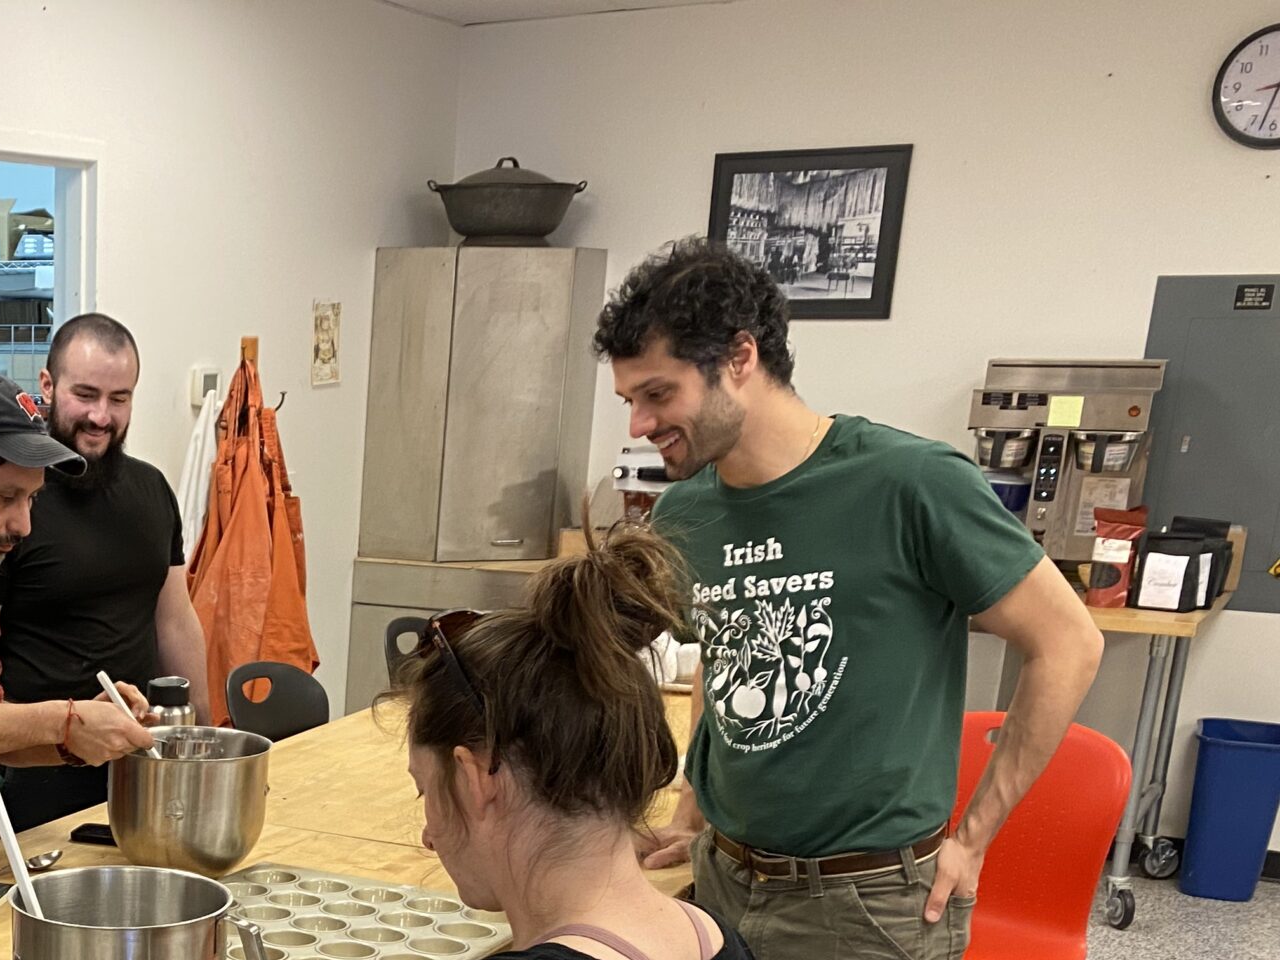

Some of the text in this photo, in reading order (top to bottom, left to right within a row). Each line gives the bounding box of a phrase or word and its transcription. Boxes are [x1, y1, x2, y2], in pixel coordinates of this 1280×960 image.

[1259, 44, 1269, 56] 11
[1240, 62, 1253, 74] 10
[1232, 82, 1242, 94] 9
[1250, 114, 1259, 126] 7
[1269, 120, 1277, 131] 6
[723, 537, 783, 567] Irish
[692, 571, 834, 604] Seed Savers
[732, 743, 751, 754] crop
[751, 739, 783, 752] heritage
[782, 730, 796, 744] for
[794, 710, 819, 733] future
[817, 656, 849, 712] generations
